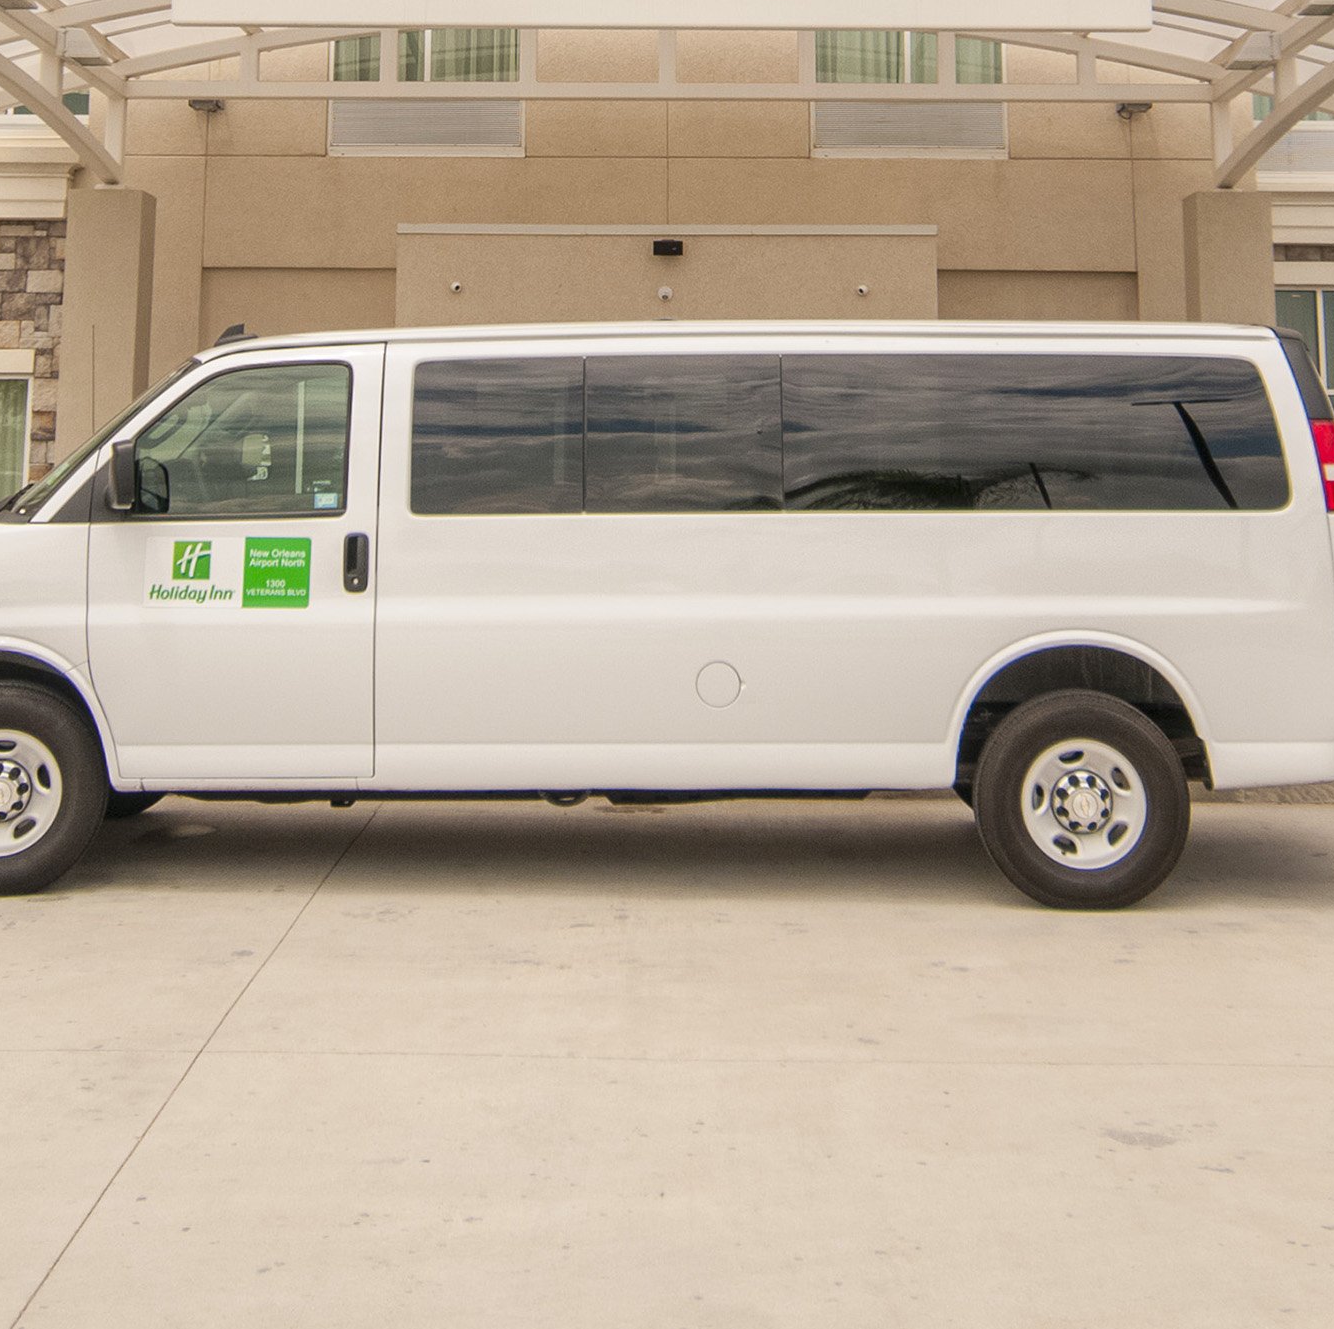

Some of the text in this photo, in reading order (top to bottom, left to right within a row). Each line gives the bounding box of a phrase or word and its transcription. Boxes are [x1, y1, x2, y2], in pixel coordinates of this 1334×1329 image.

[250, 549, 305, 558] New Orleans
[249, 558, 305, 568] Airport North
[266, 579, 285, 588] 1300
[149, 584, 233, 604] Holiday Inn
[246, 588, 306, 596] VETERANS BLVD
